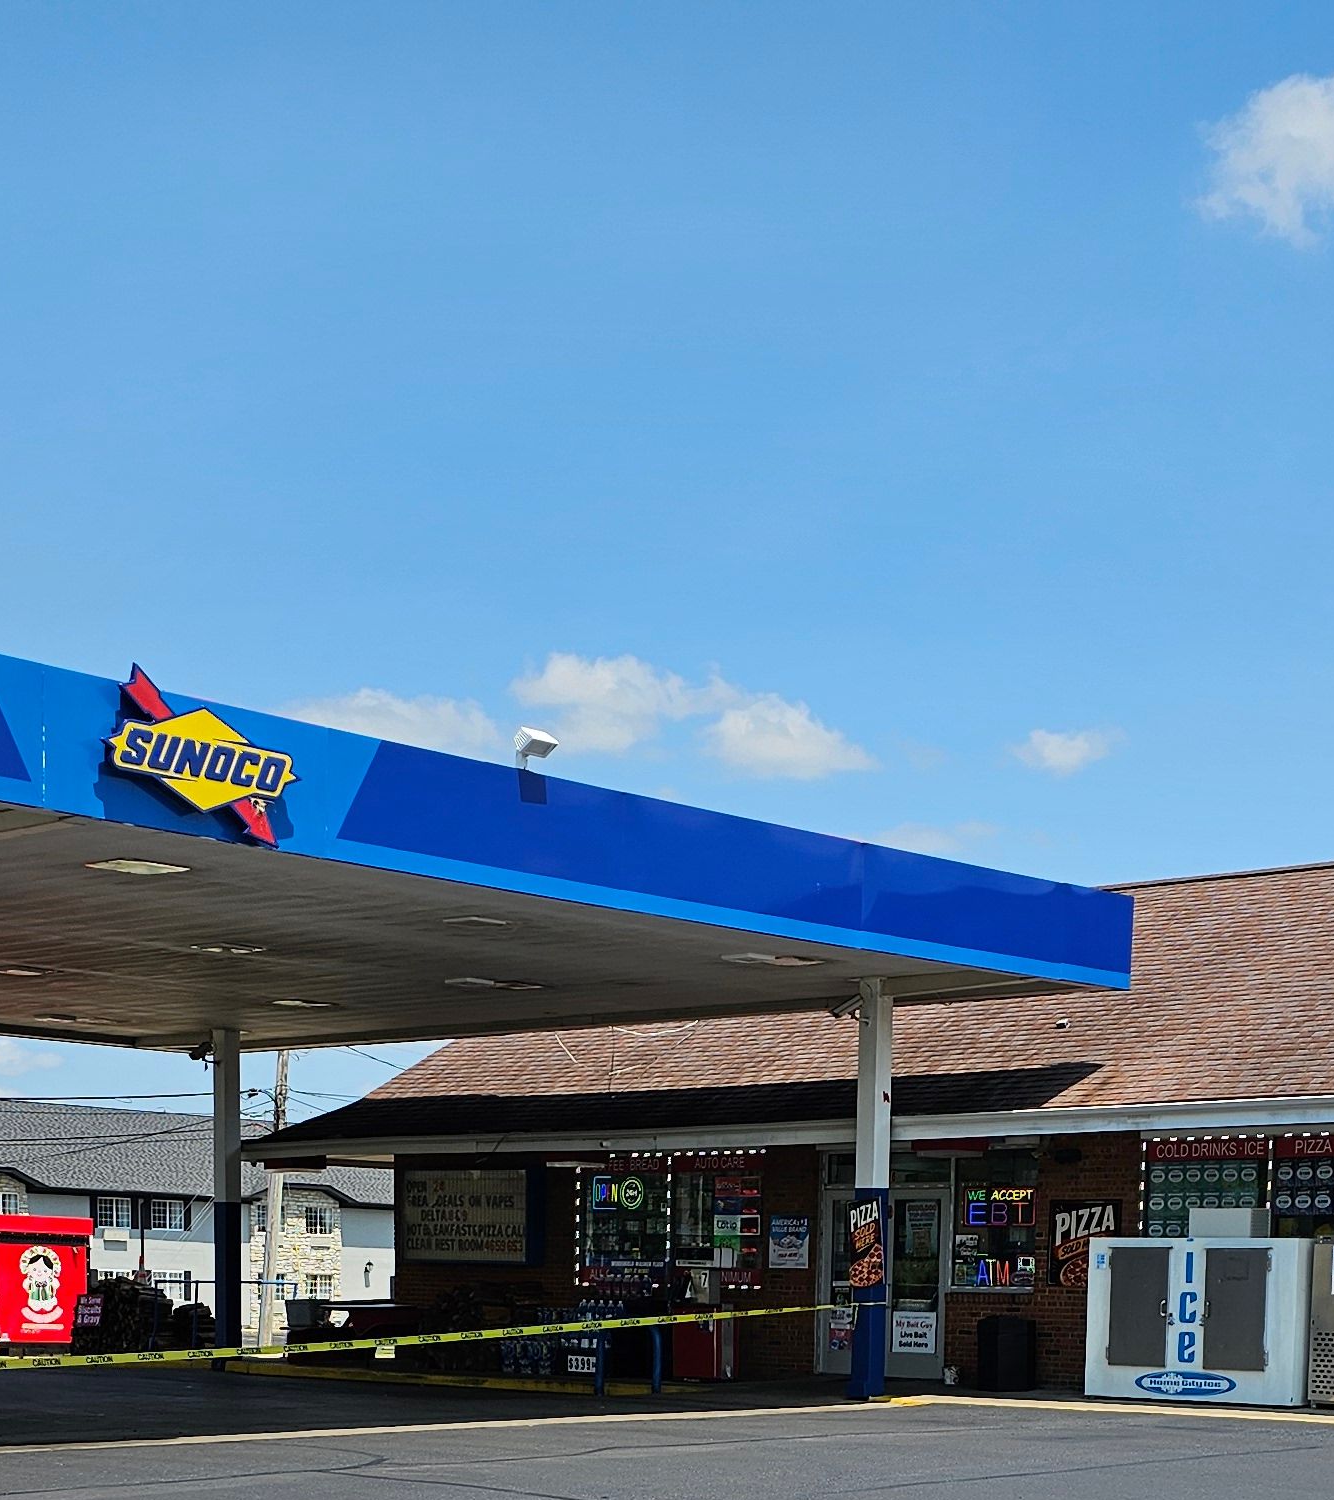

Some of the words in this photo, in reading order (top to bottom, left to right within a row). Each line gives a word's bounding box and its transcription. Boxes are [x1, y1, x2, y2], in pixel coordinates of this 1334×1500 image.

[119, 727, 287, 793] SUNOCO
[1157, 1144, 1189, 1158] COLD
[1191, 1142, 1238, 1157] DRINKS
[1243, 1141, 1265, 1155] ICE
[1295, 1140, 1333, 1155] PIZZA
[629, 1159, 660, 1171] BREAD
[694, 1156, 718, 1169] AUTO
[721, 1156, 745, 1168] CARE
[595, 1183, 619, 1203] OPEN
[967, 1189, 987, 1201] WE
[990, 1189, 1034, 1201] ACCEPT
[850, 1200, 880, 1233] PIZZA
[969, 1202, 1030, 1225] EBT
[854, 1222, 876, 1240] SOLD
[1055, 1204, 1116, 1247] PIZZA
[855, 1232, 876, 1250] HERE
[977, 1258, 1010, 1287] ATM
[914, 1331, 928, 1339] Bait
[32, 1357, 61, 1367] CAUTION
[85, 1355, 113, 1363] CAUTION
[137, 1352, 165, 1361] CAUTION
[187, 1349, 214, 1358] CAUTION
[237, 1347, 262, 1355] CAUTION
[284, 1344, 309, 1353] CAUTION
[1149, 1379, 1180, 1387] Home
[1182, 1380, 1204, 1388] City
